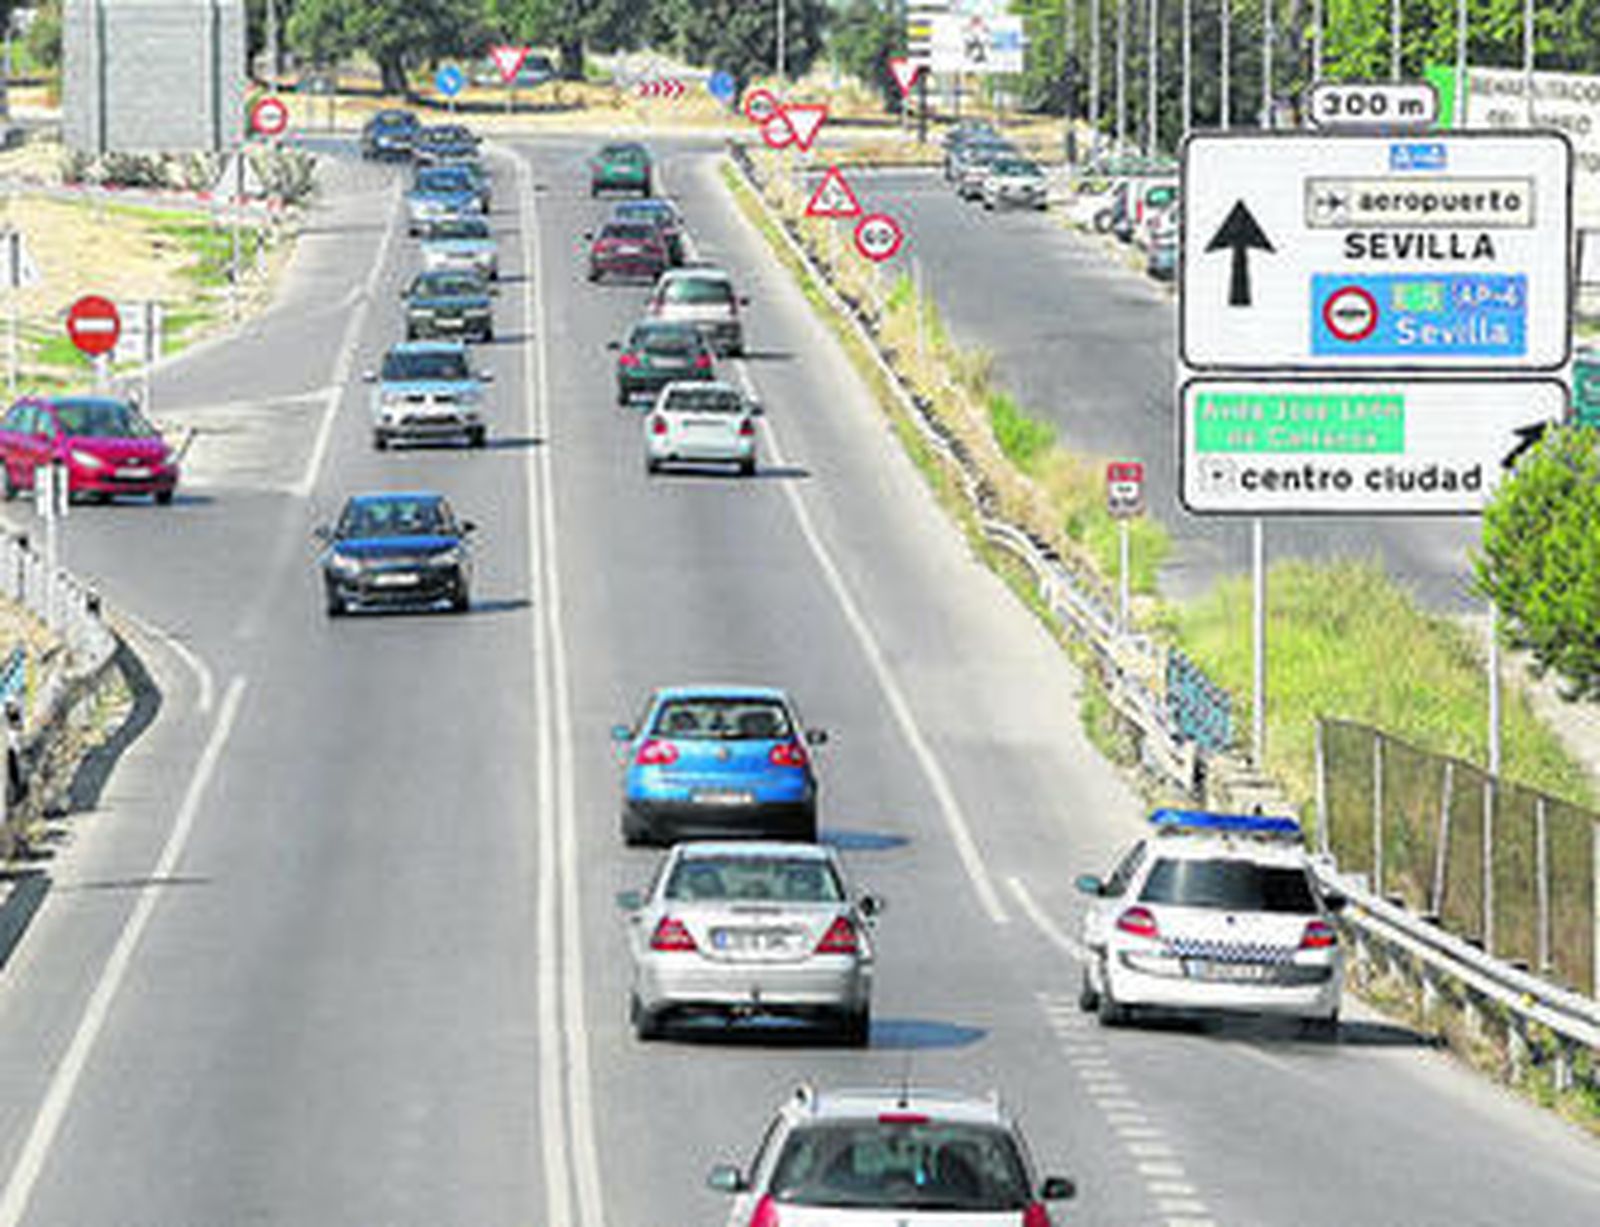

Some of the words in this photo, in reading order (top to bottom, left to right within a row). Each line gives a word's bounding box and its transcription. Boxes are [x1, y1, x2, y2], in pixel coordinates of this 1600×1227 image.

[1323, 93, 1387, 116] 300
[1399, 99, 1425, 115] m
[1357, 189, 1521, 212] aeropuerto
[1344, 233, 1496, 260] SEVILLA
[1396, 313, 1510, 345] Sevilla
[1240, 464, 1354, 491] centro
[1365, 463, 1483, 491] ciudad
